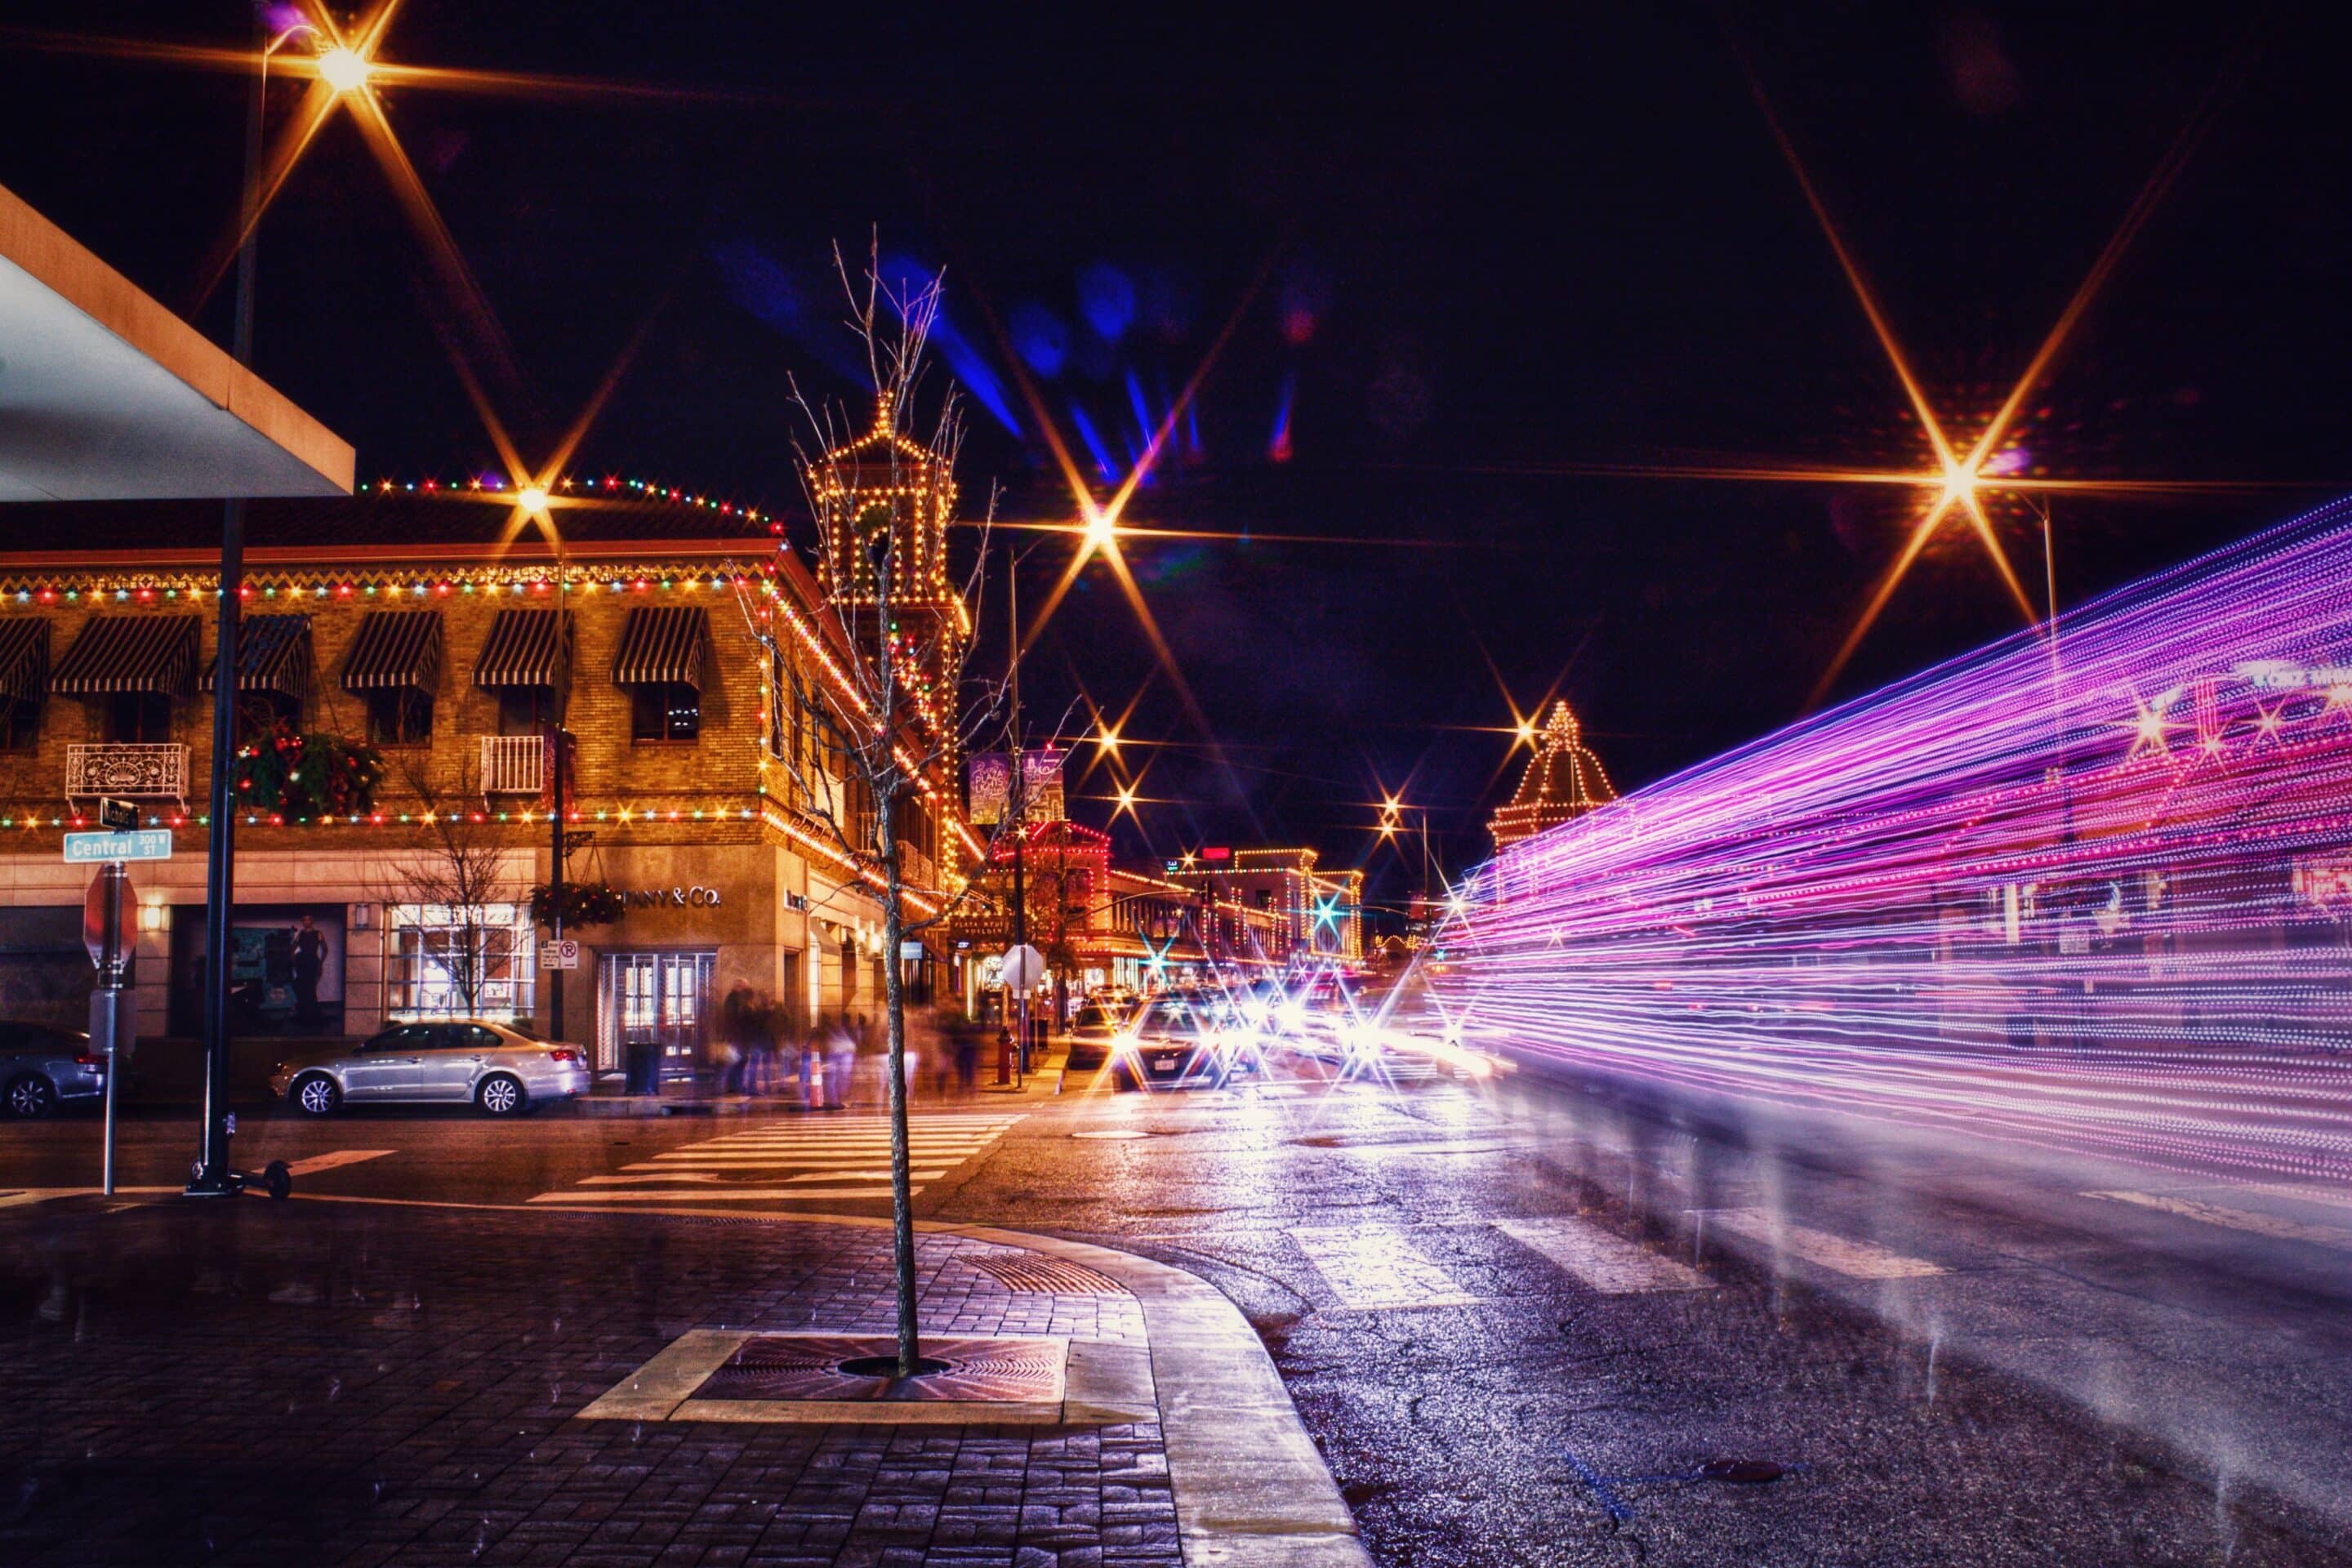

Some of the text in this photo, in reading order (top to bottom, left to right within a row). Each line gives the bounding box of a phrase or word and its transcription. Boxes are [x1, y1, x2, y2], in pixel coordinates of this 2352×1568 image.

[139, 835, 156, 844] 300
[72, 840, 131, 856] Central
[143, 845, 156, 855] ST
[672, 887, 686, 905] &
